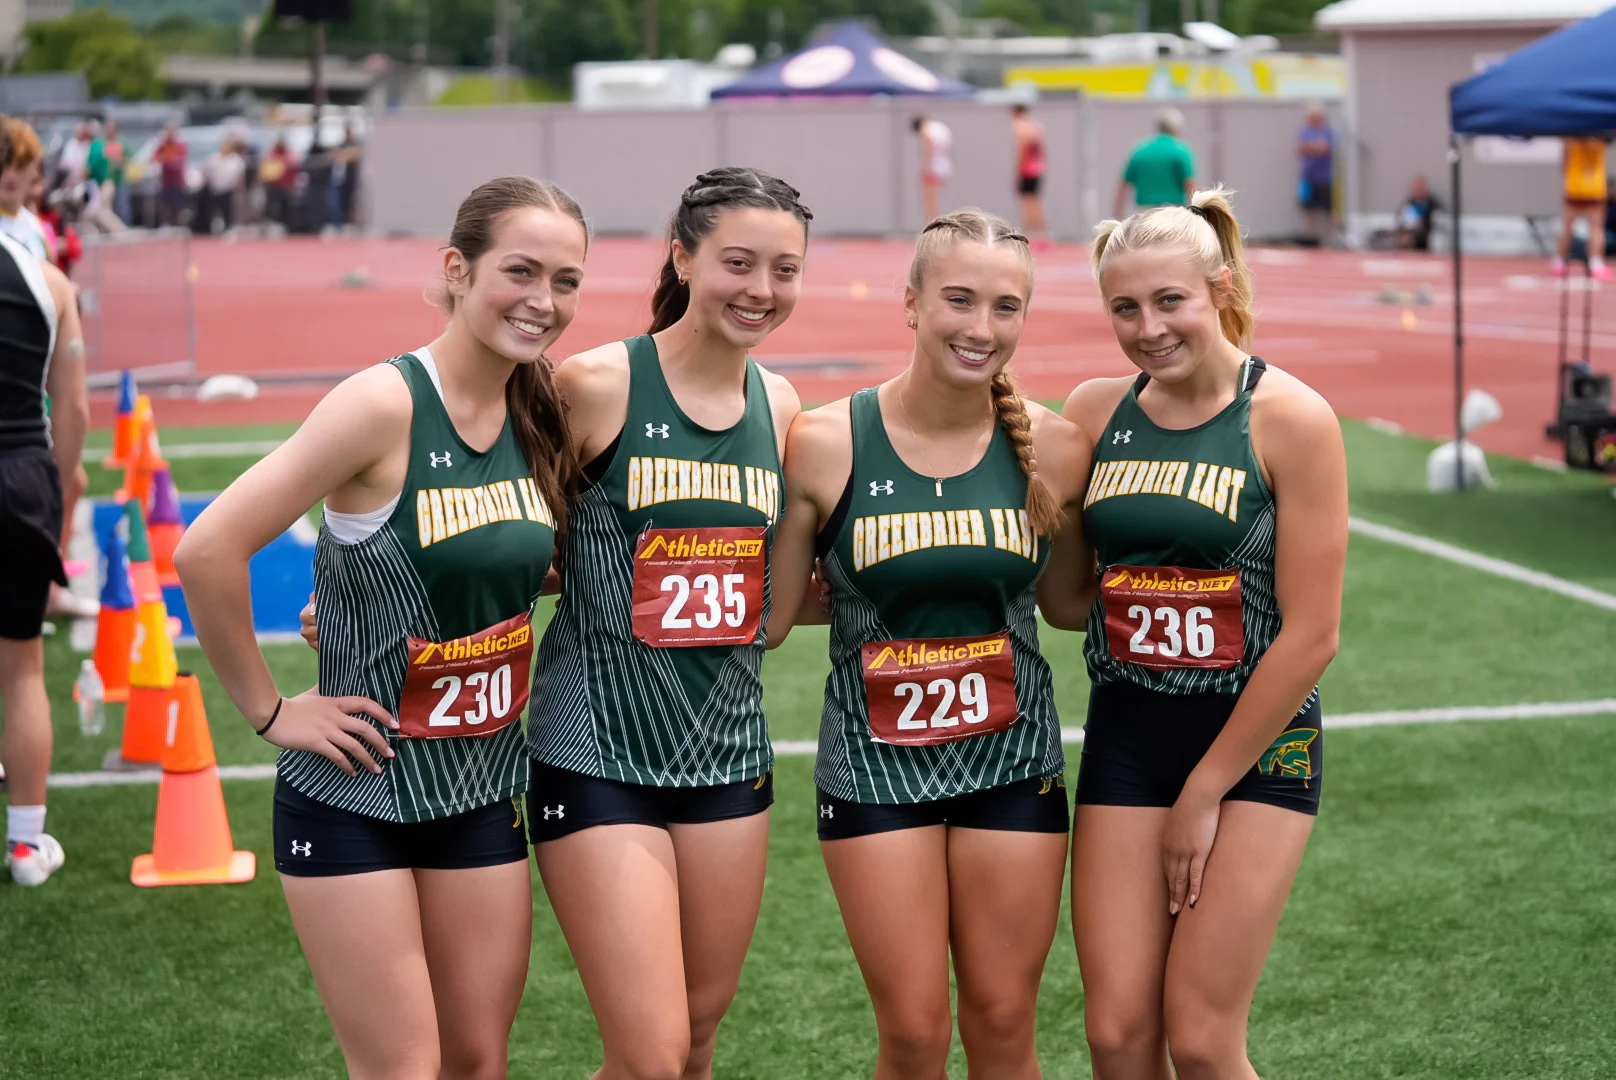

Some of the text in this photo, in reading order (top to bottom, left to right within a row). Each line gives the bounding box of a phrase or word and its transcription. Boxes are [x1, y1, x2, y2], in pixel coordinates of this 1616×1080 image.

[416, 477, 556, 549] GREENBRIER EA
[628, 456, 779, 526] GREENBRIER EAST
[1187, 462, 1247, 523] EAST
[853, 509, 987, 573] GREENBRIER
[660, 573, 746, 629] 235
[1127, 604, 1215, 658] 236
[428, 663, 512, 727] 230
[893, 672, 989, 731] 229
